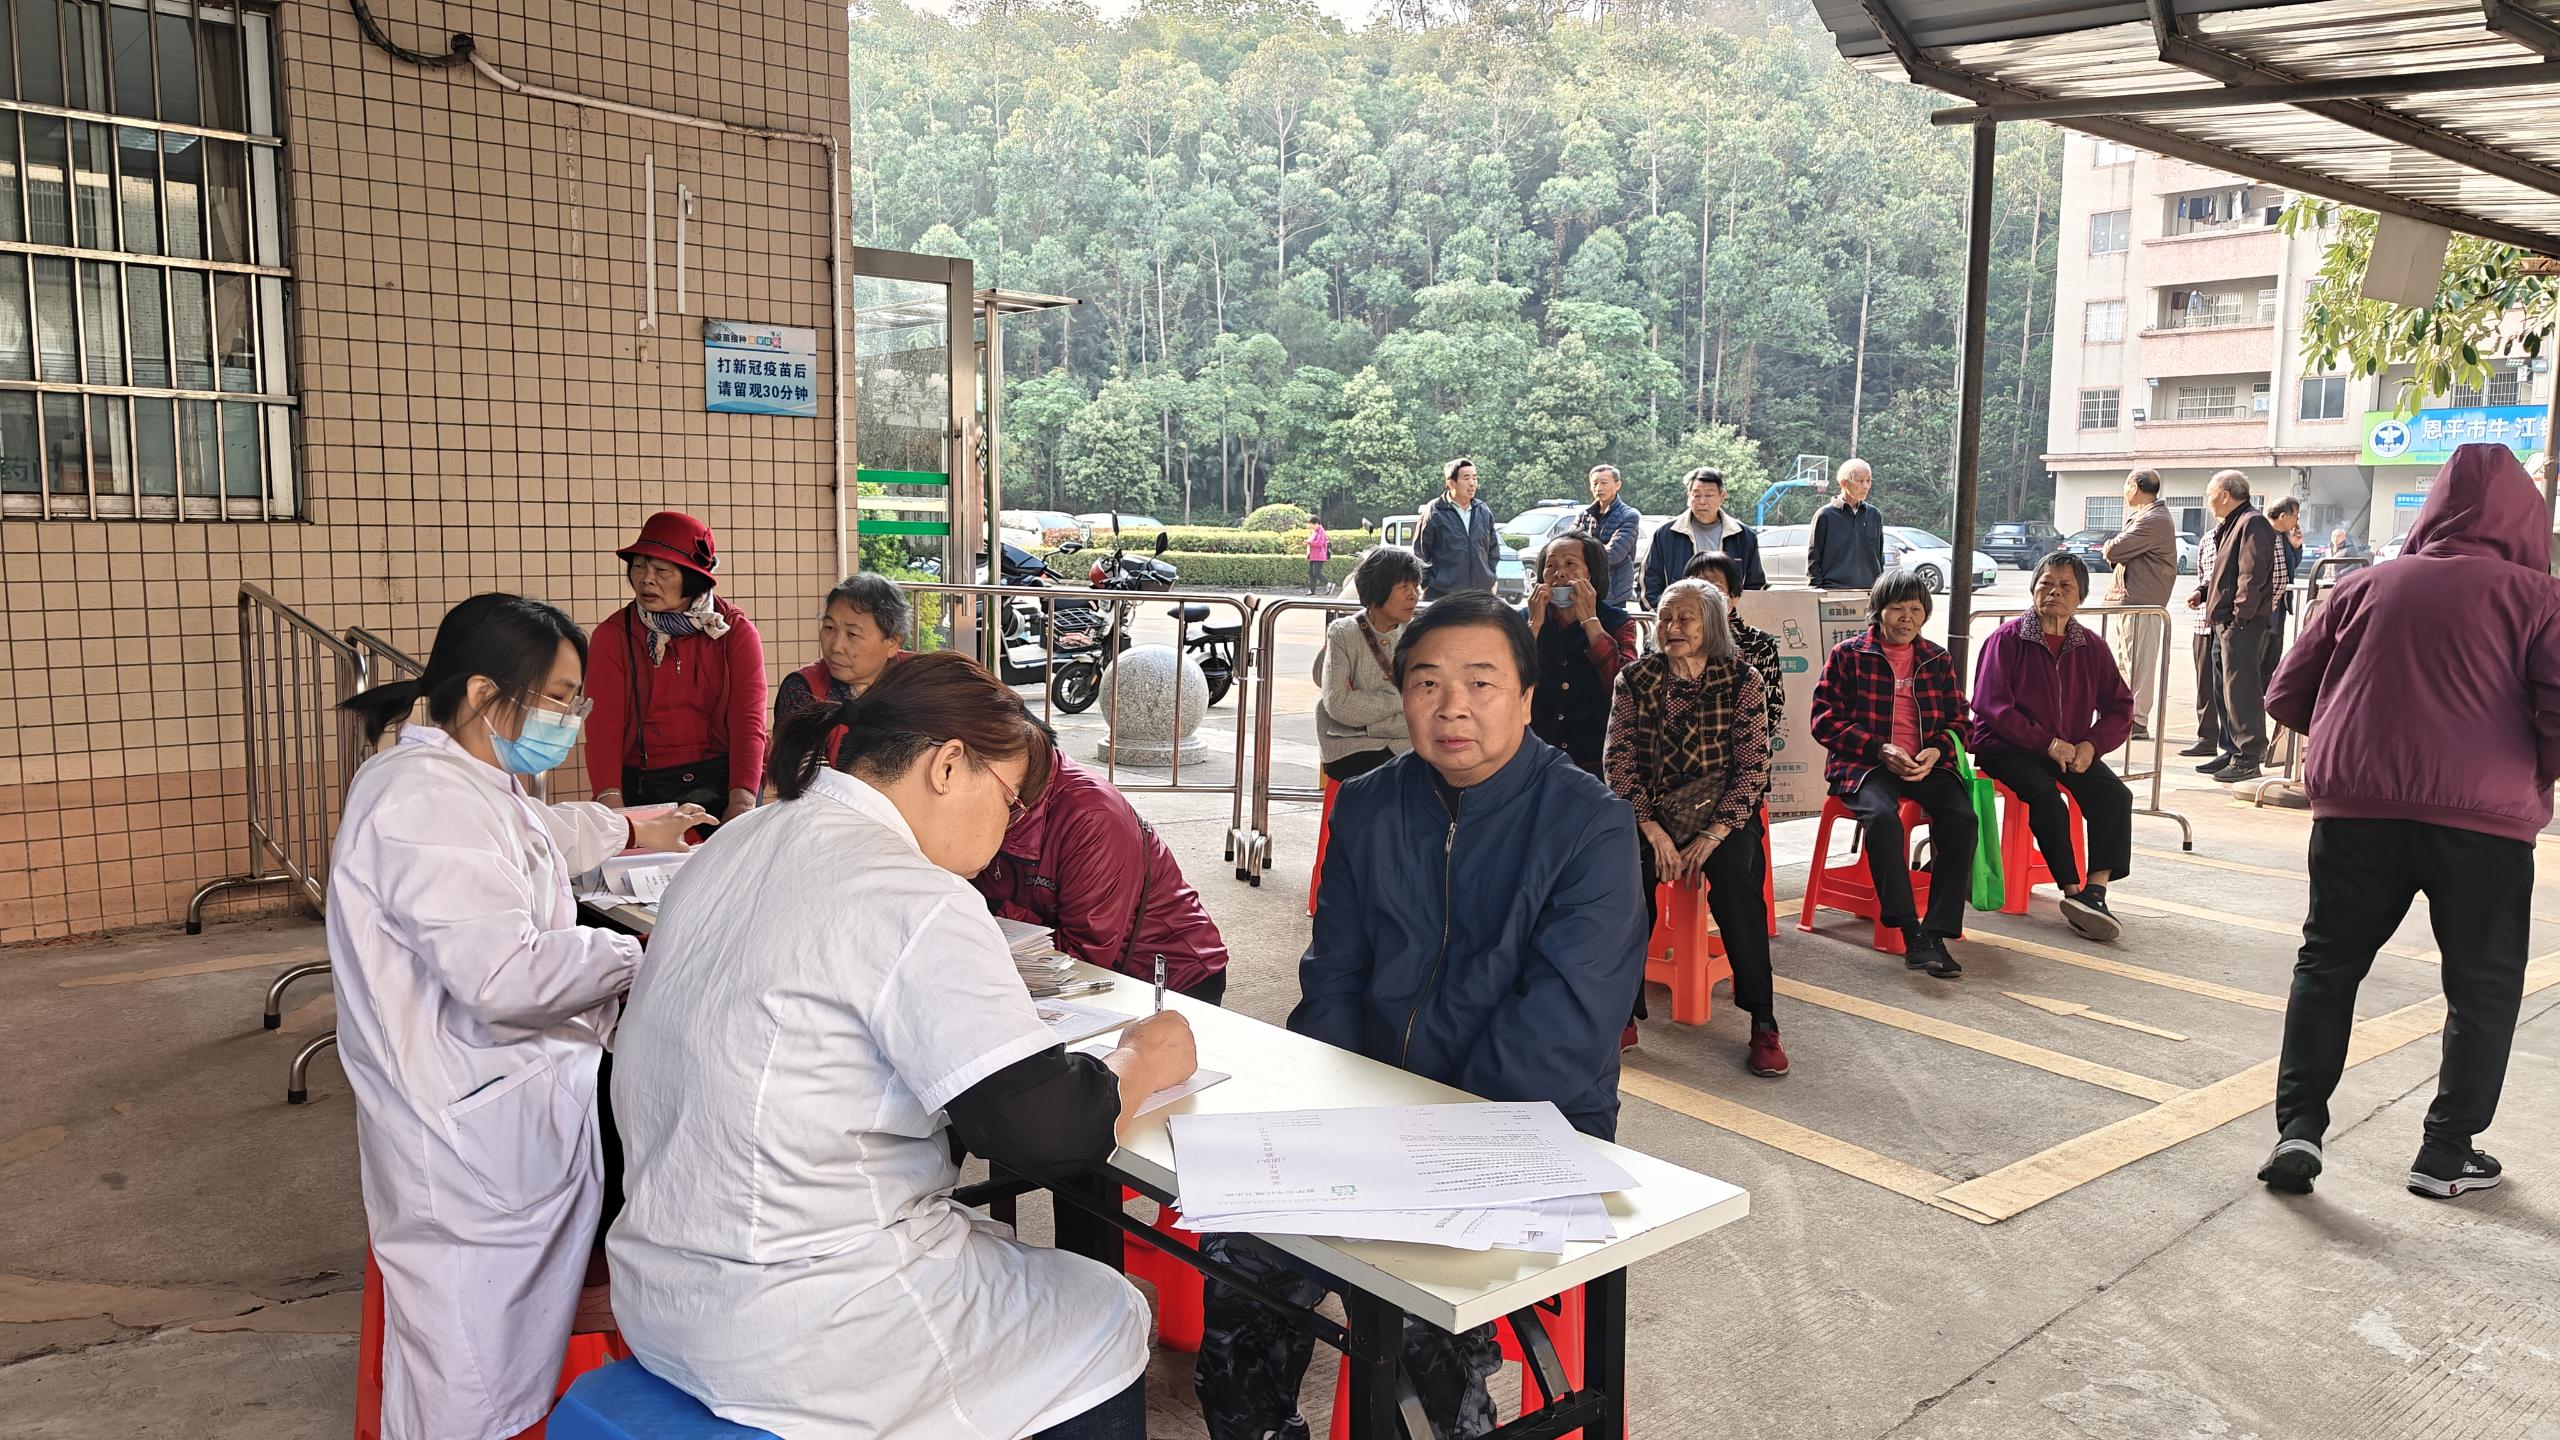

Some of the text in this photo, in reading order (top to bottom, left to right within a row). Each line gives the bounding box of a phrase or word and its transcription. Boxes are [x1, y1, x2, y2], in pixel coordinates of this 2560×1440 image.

[717, 357, 807, 379] 打新冠疫苗后
[717, 380, 808, 402] 请留观30分钟
